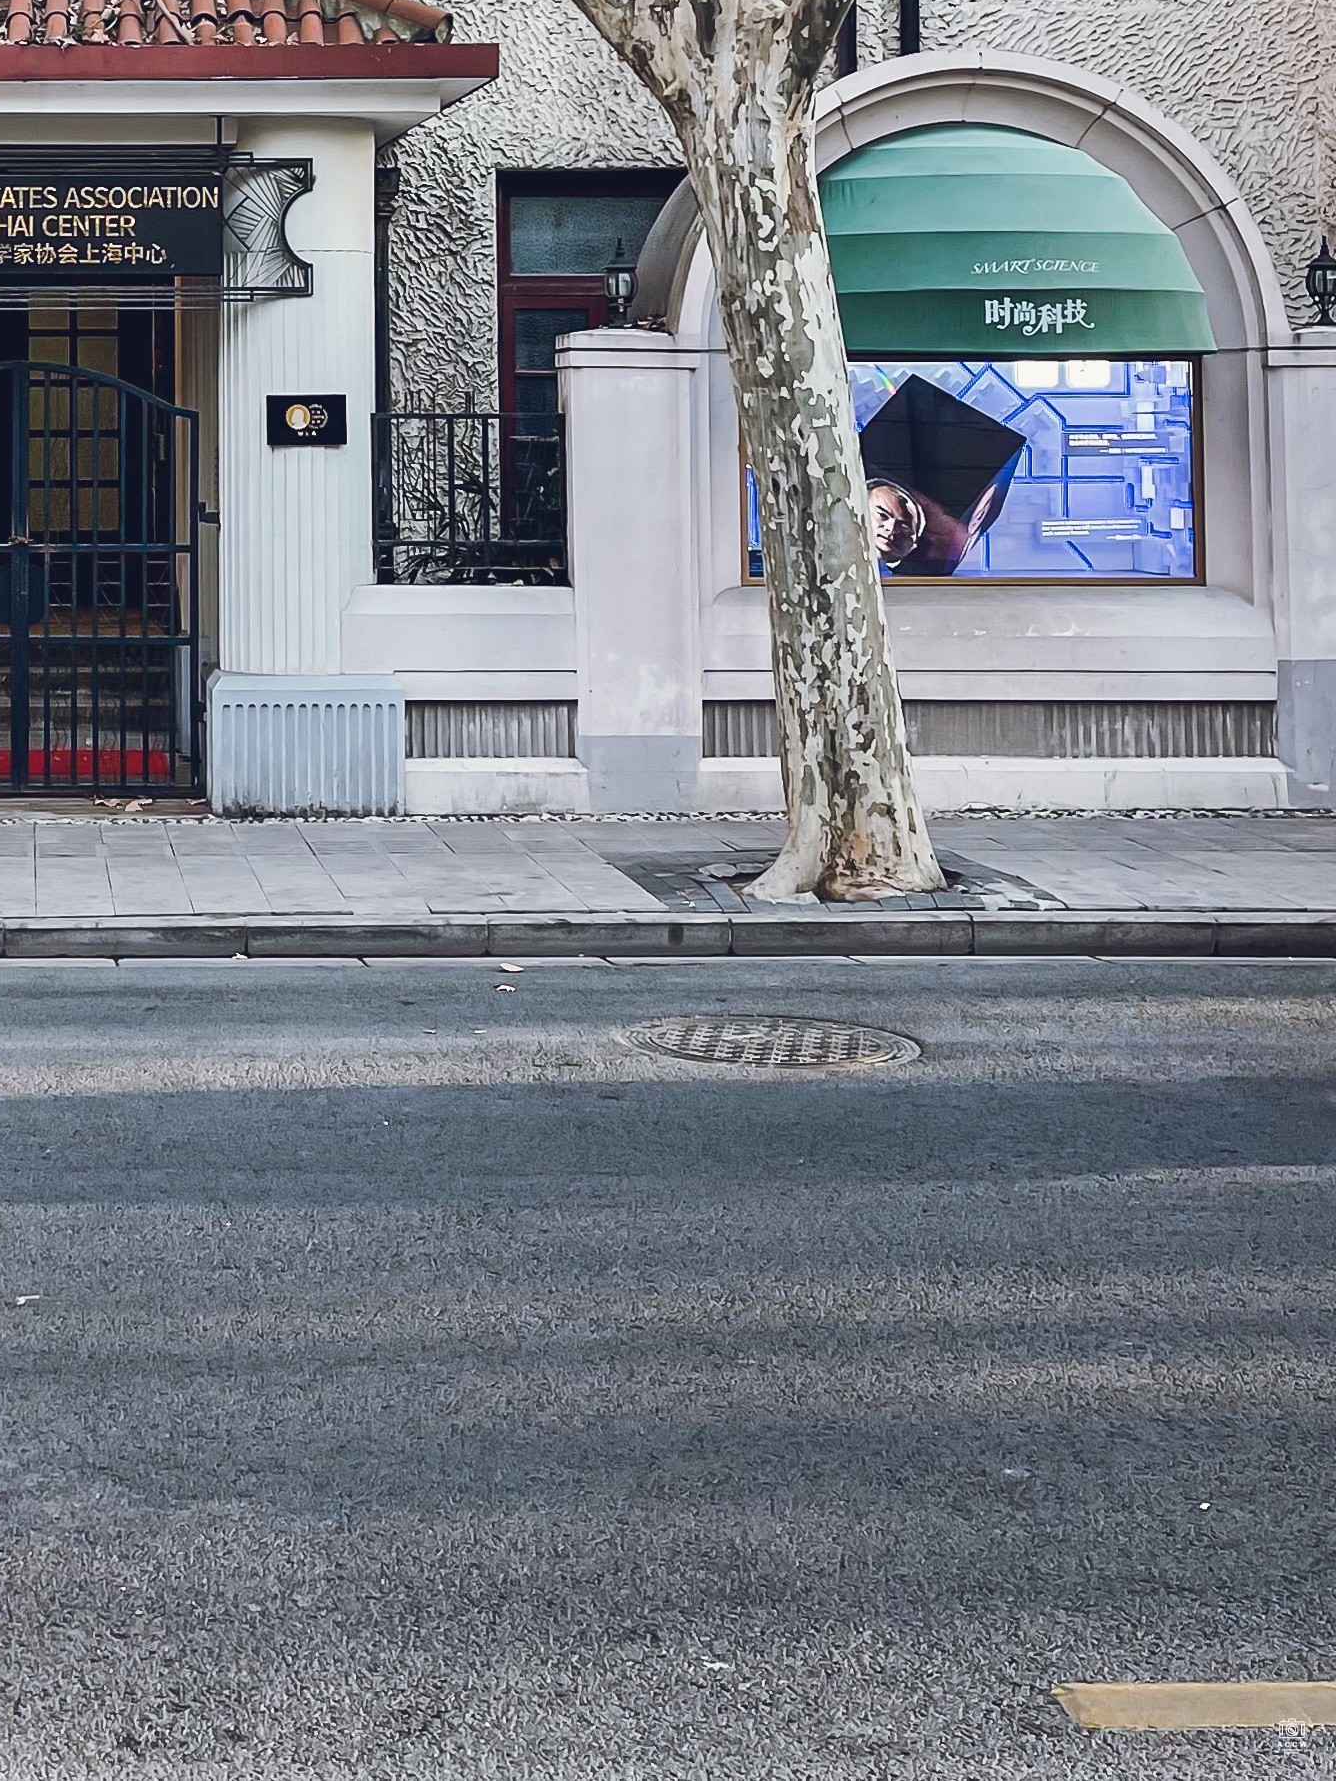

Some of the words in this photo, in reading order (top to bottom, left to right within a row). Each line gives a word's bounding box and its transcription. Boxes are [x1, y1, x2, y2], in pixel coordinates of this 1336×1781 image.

[63, 186, 219, 209] ASSOCIATION
[42, 215, 136, 237] CENTER
[970, 258, 1035, 274] SMART
[1034, 259, 1100, 273] SCIENCE
[984, 297, 1095, 336] 时尚科技
